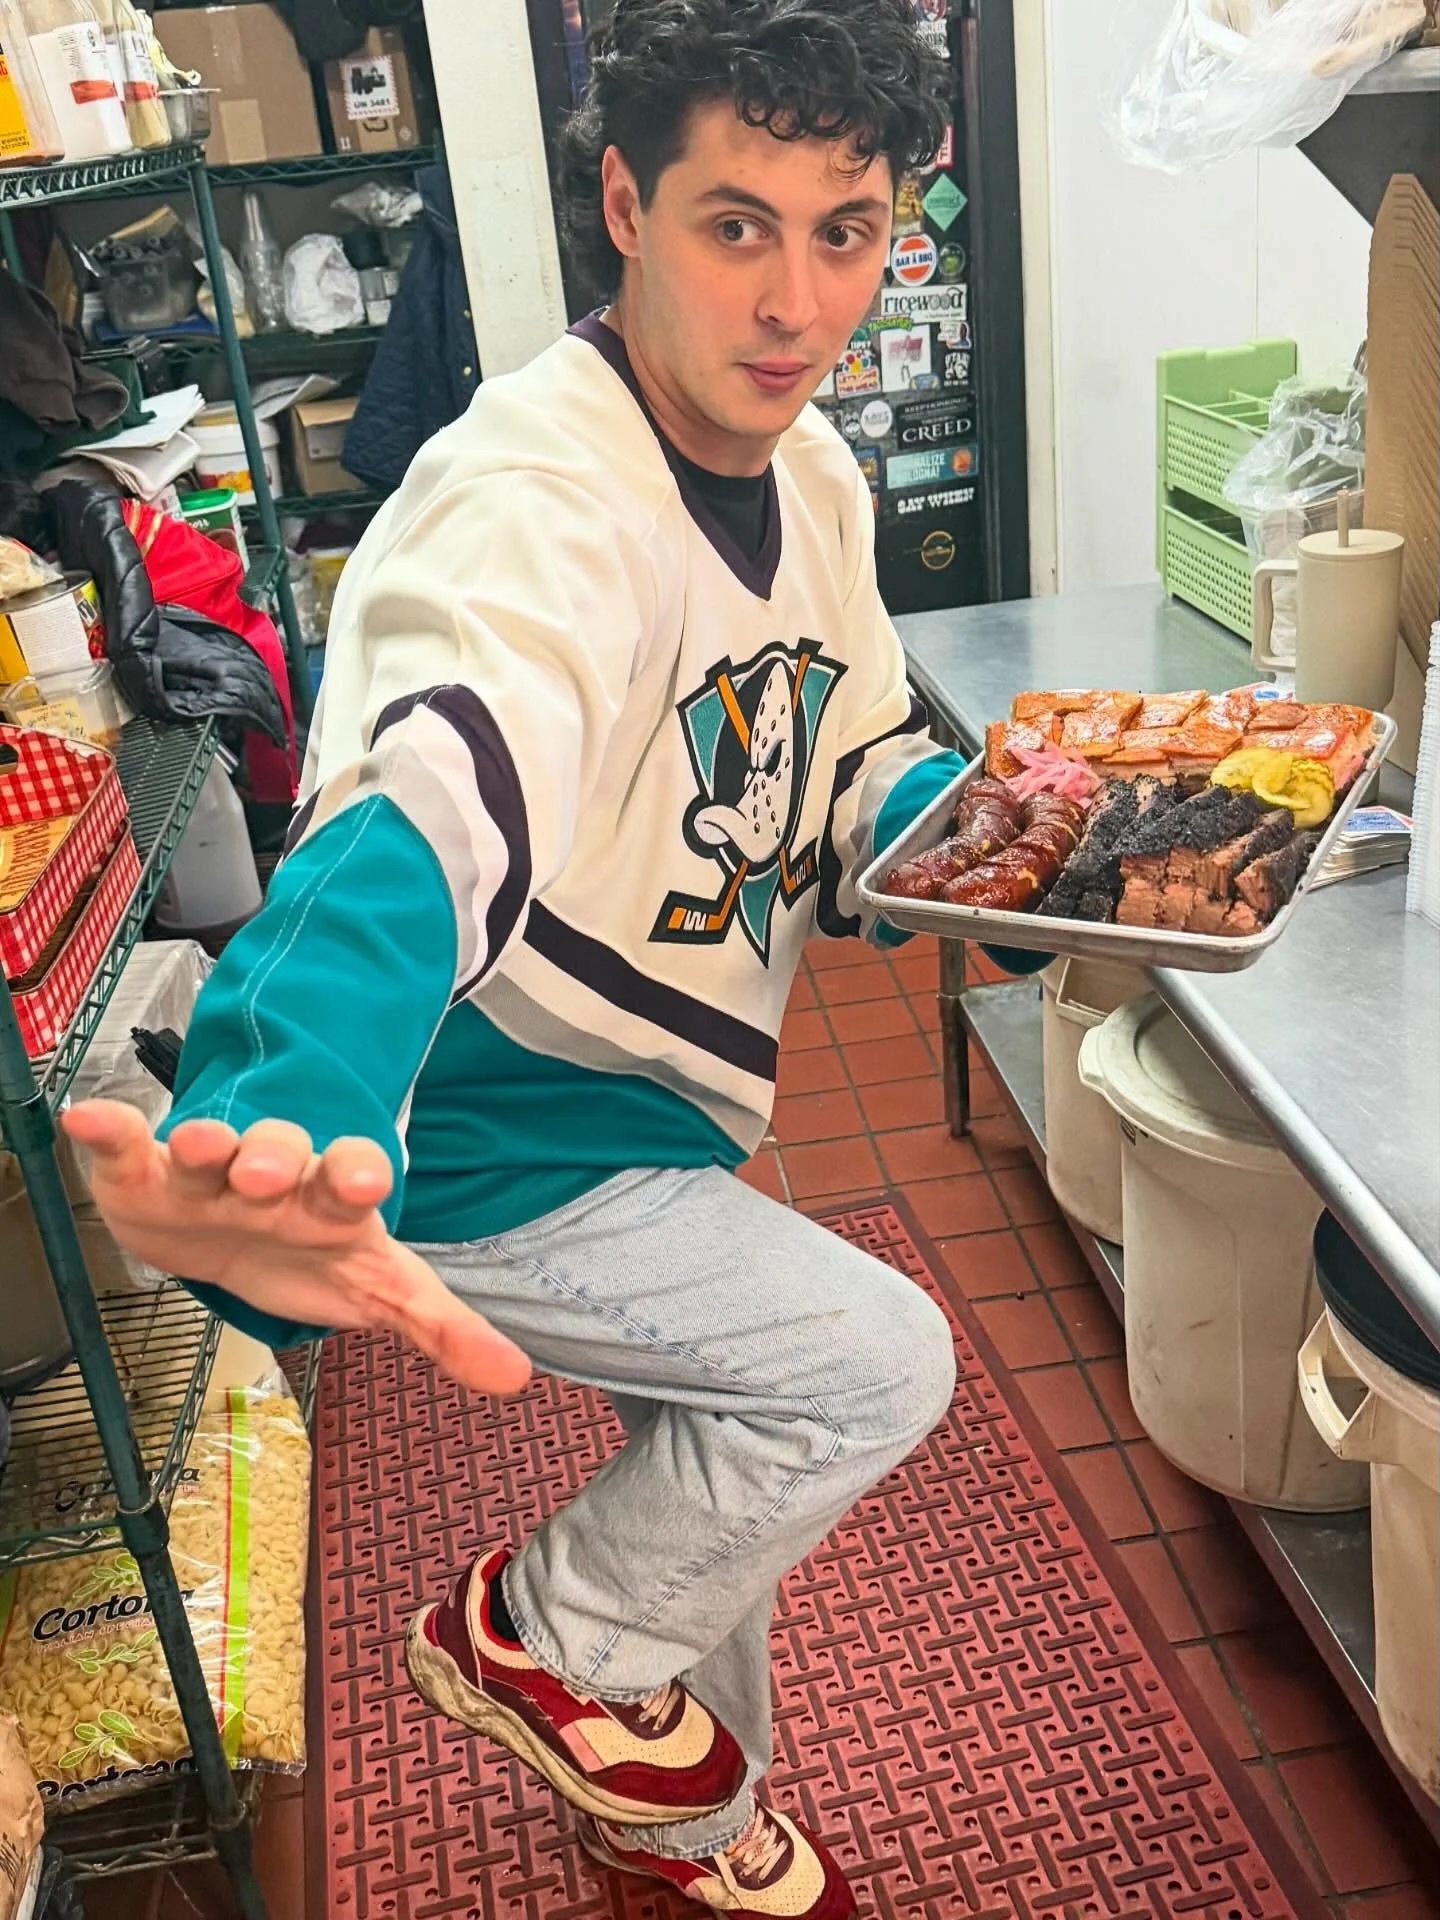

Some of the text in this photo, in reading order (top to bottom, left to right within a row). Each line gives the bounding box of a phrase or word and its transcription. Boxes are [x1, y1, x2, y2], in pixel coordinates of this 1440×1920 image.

[885, 286, 964, 313] ricewood
[902, 418, 971, 442] CREED
[897, 496, 926, 514] SAY
[33, 1589, 195, 1641] Corto
